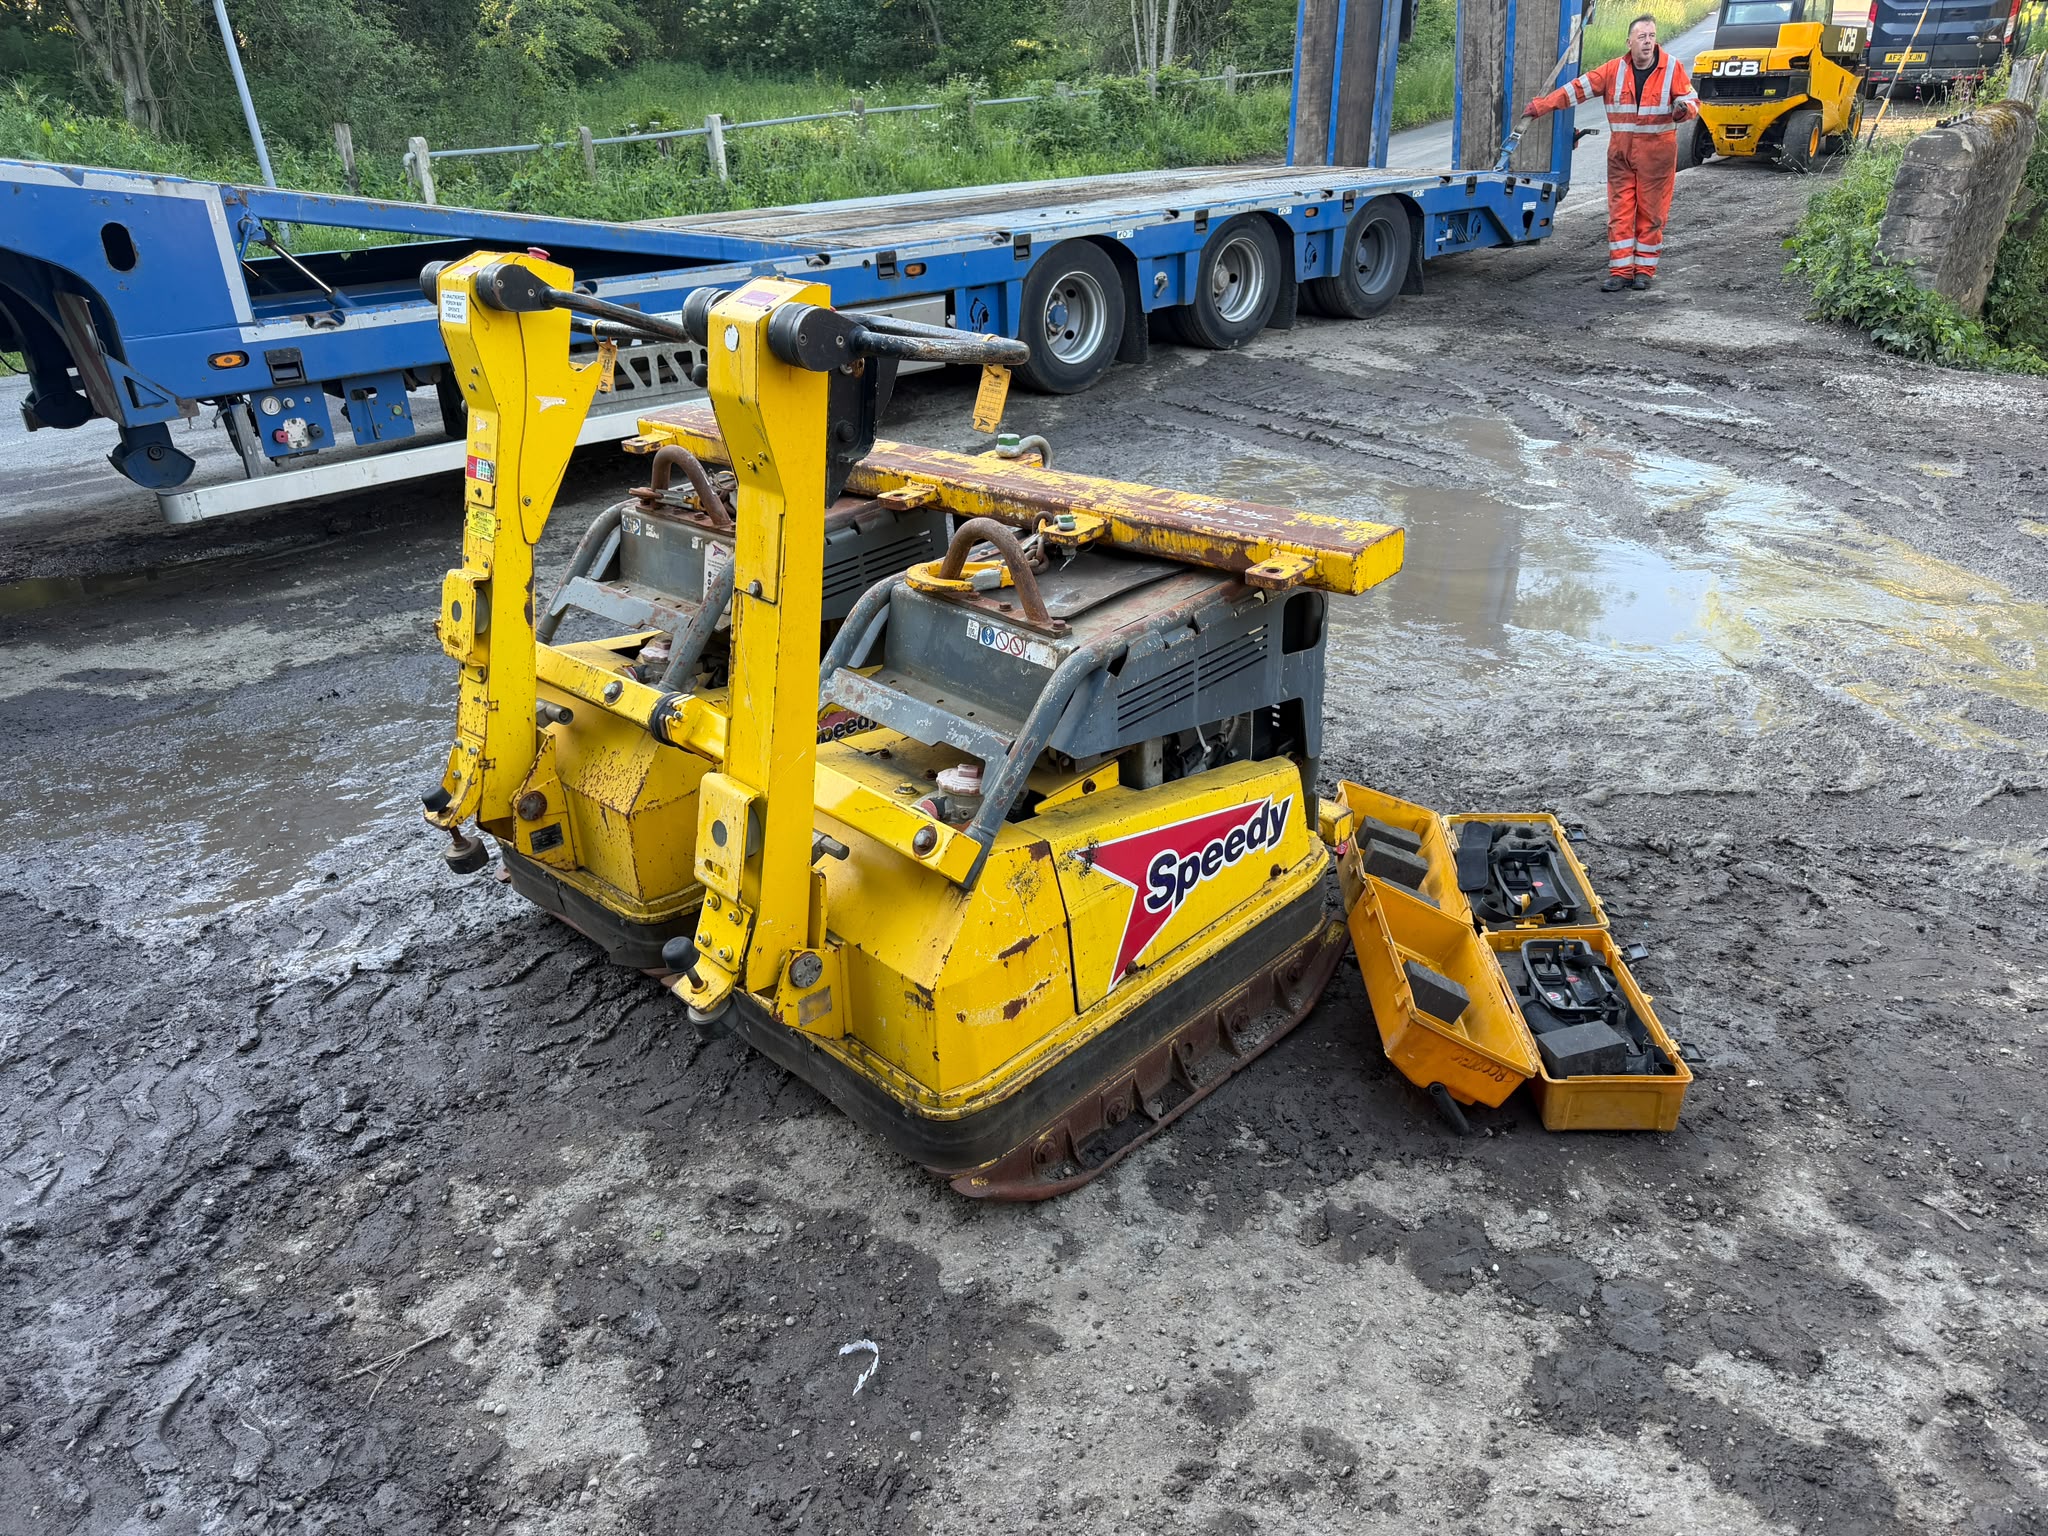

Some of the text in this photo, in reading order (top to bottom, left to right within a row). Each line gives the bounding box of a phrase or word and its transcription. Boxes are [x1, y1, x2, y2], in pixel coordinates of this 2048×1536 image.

[1838, 27, 1858, 52] JCB
[1712, 61, 1759, 76] JCB
[1145, 796, 1292, 911] Speedy
